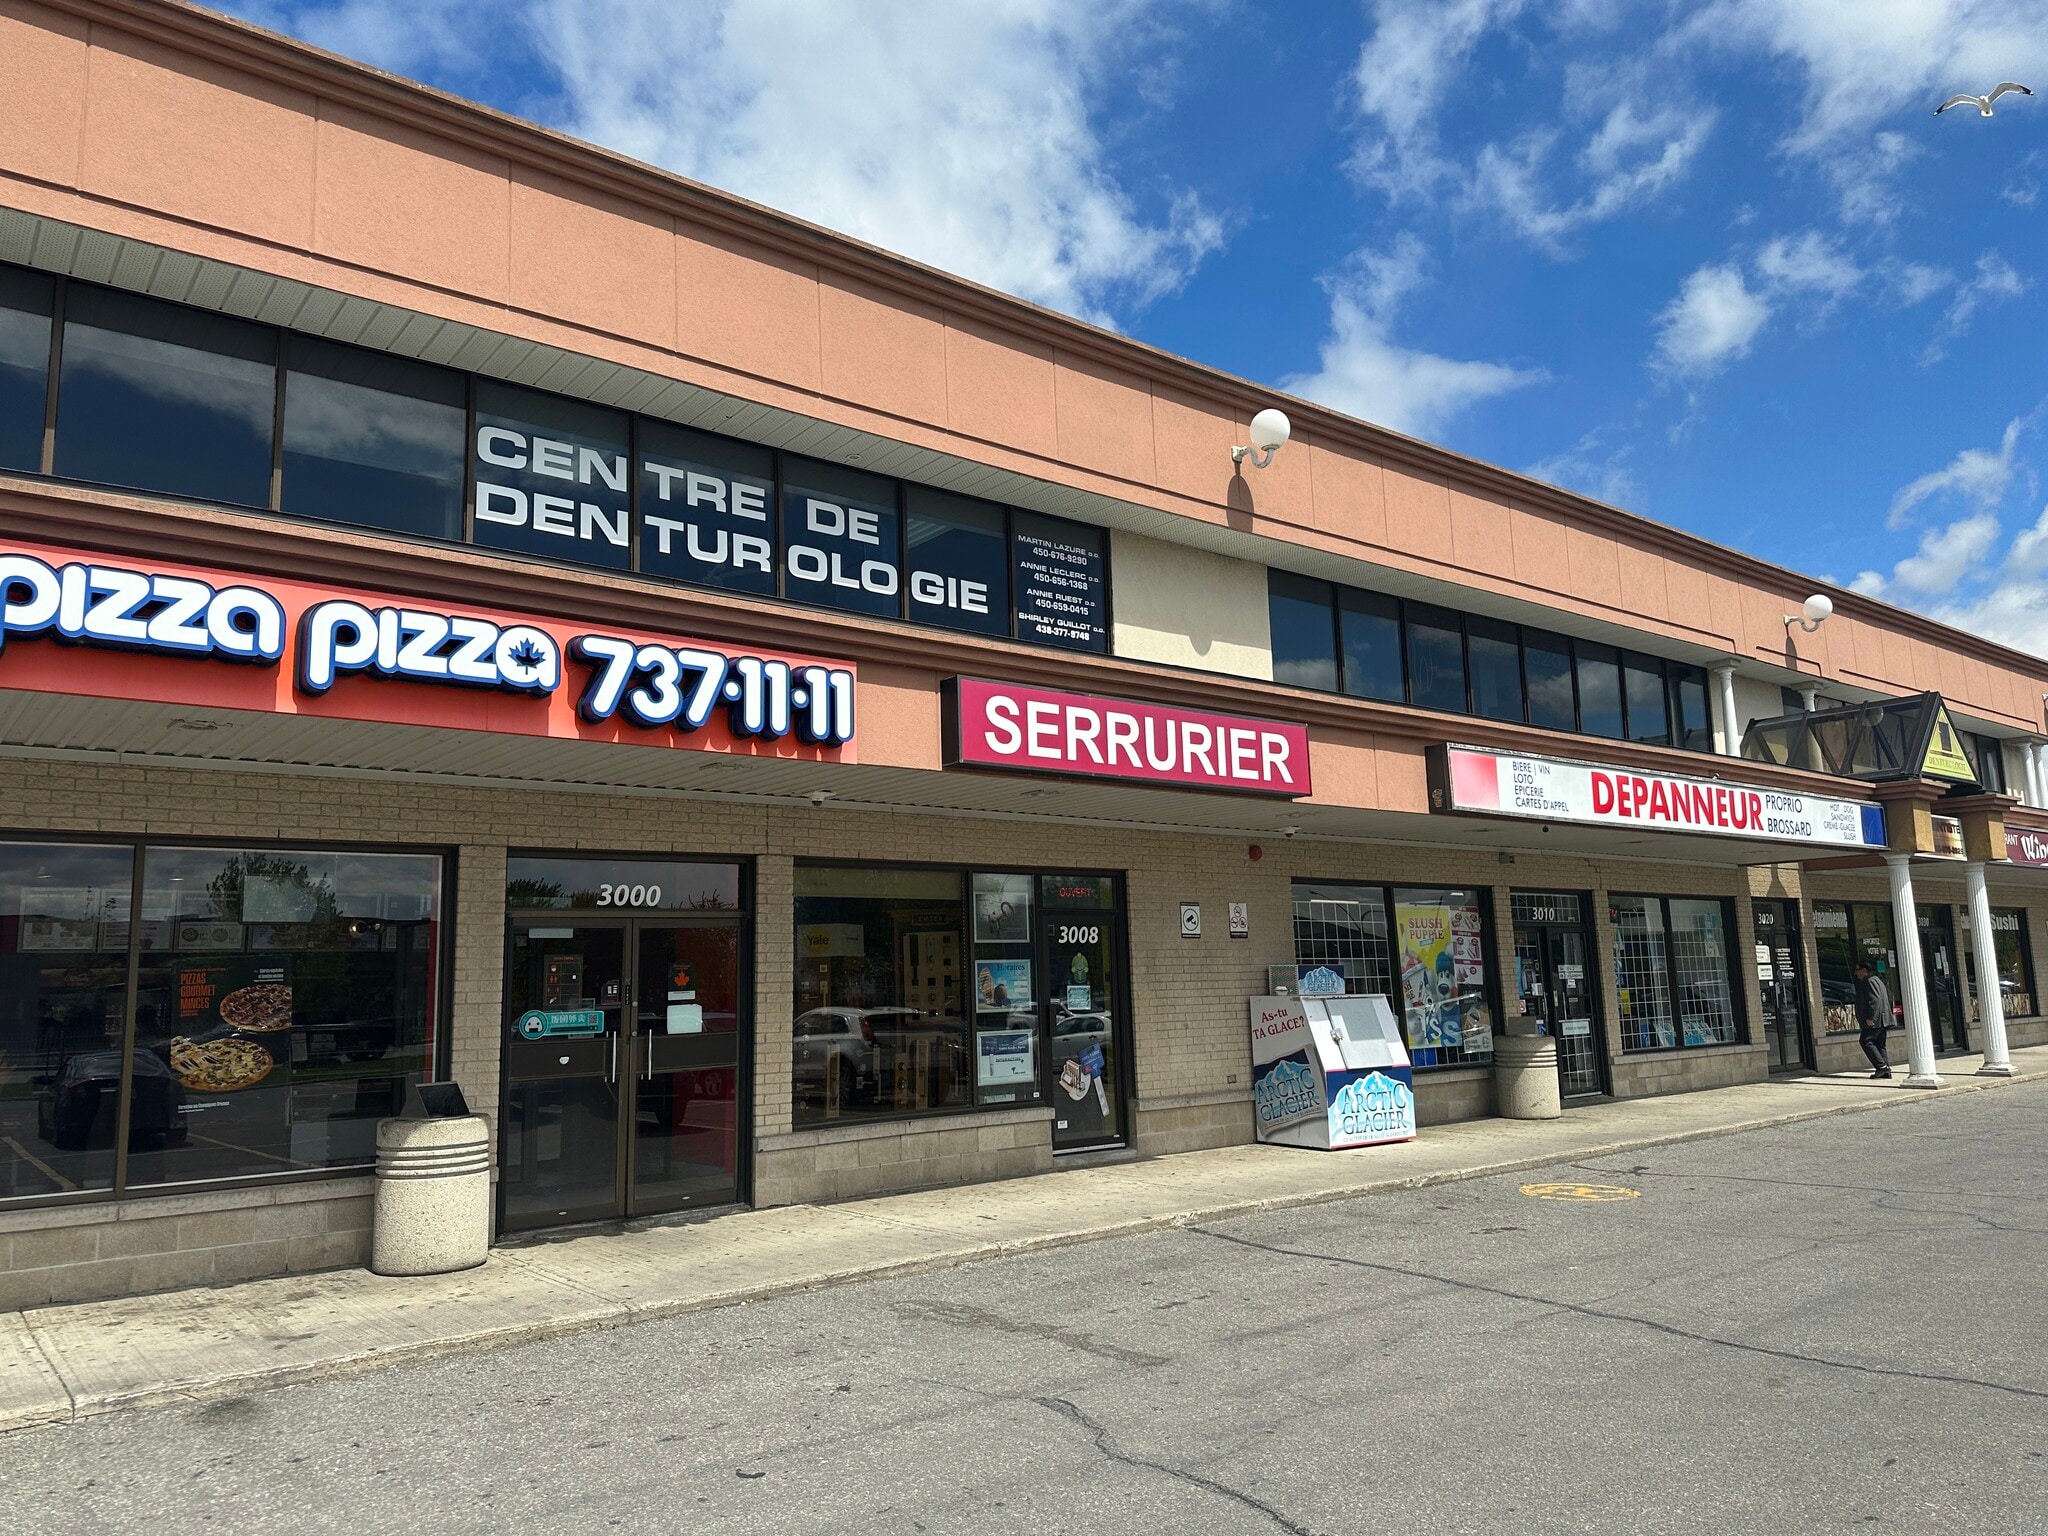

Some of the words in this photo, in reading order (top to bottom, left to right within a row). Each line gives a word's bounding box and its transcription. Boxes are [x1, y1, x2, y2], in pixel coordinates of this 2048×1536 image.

[806, 497, 880, 545] DE
[1018, 534, 1052, 548] MARTIN
[1053, 542, 1087, 556] LAZURE
[1032, 546, 1088, 566] 450-676-9290
[1020, 561, 1048, 573] ANNIE
[1049, 566, 1087, 580] LECLERC
[1033, 572, 1088, 591] 450-656-1368
[1026, 588, 1054, 599] ANNIE
[1055, 593, 1083, 605] RUEST
[1035, 598, 1089, 616] 450-659-0415
[1018, 612, 1055, 625] SHIRLEY
[1056, 619, 1092, 631] GUILLOT
[984, 694, 1294, 784] SERRURIER
[1512, 760, 1532, 773] BIERE
[1538, 763, 1551, 775] VIN
[1513, 772, 1534, 785] LOTO
[1514, 784, 1545, 798] EPICERIE
[1590, 770, 1764, 831] DEPANNEUR
[1515, 796, 1542, 810] CARTES
[1765, 794, 1803, 813] PROPRIO
[1767, 817, 1812, 837] BROSSARD
[1843, 831, 1857, 841] SLUSH
[596, 883, 662, 907] 3000
[1059, 886, 1091, 898] OUVERT
[1408, 917, 1443, 929] SLUSH
[1531, 906, 1555, 921] 3010
[1758, 912, 1774, 925] 3020
[1990, 913, 2019, 930] Sushi
[806, 934, 830, 946] Yale
[1058, 925, 1099, 944] 3008
[180, 972, 207, 985] PIZZAS
[1261, 1007, 1288, 1023] As-tu
[1253, 1028, 1266, 1040] TA
[1267, 1015, 1305, 1036] GLACE?
[1256, 1067, 1315, 1105] ARCTIC
[1260, 1089, 1321, 1122] GLACIER
[1341, 1082, 1407, 1115] ARCTIC
[1342, 1110, 1408, 1135] GLACIER
